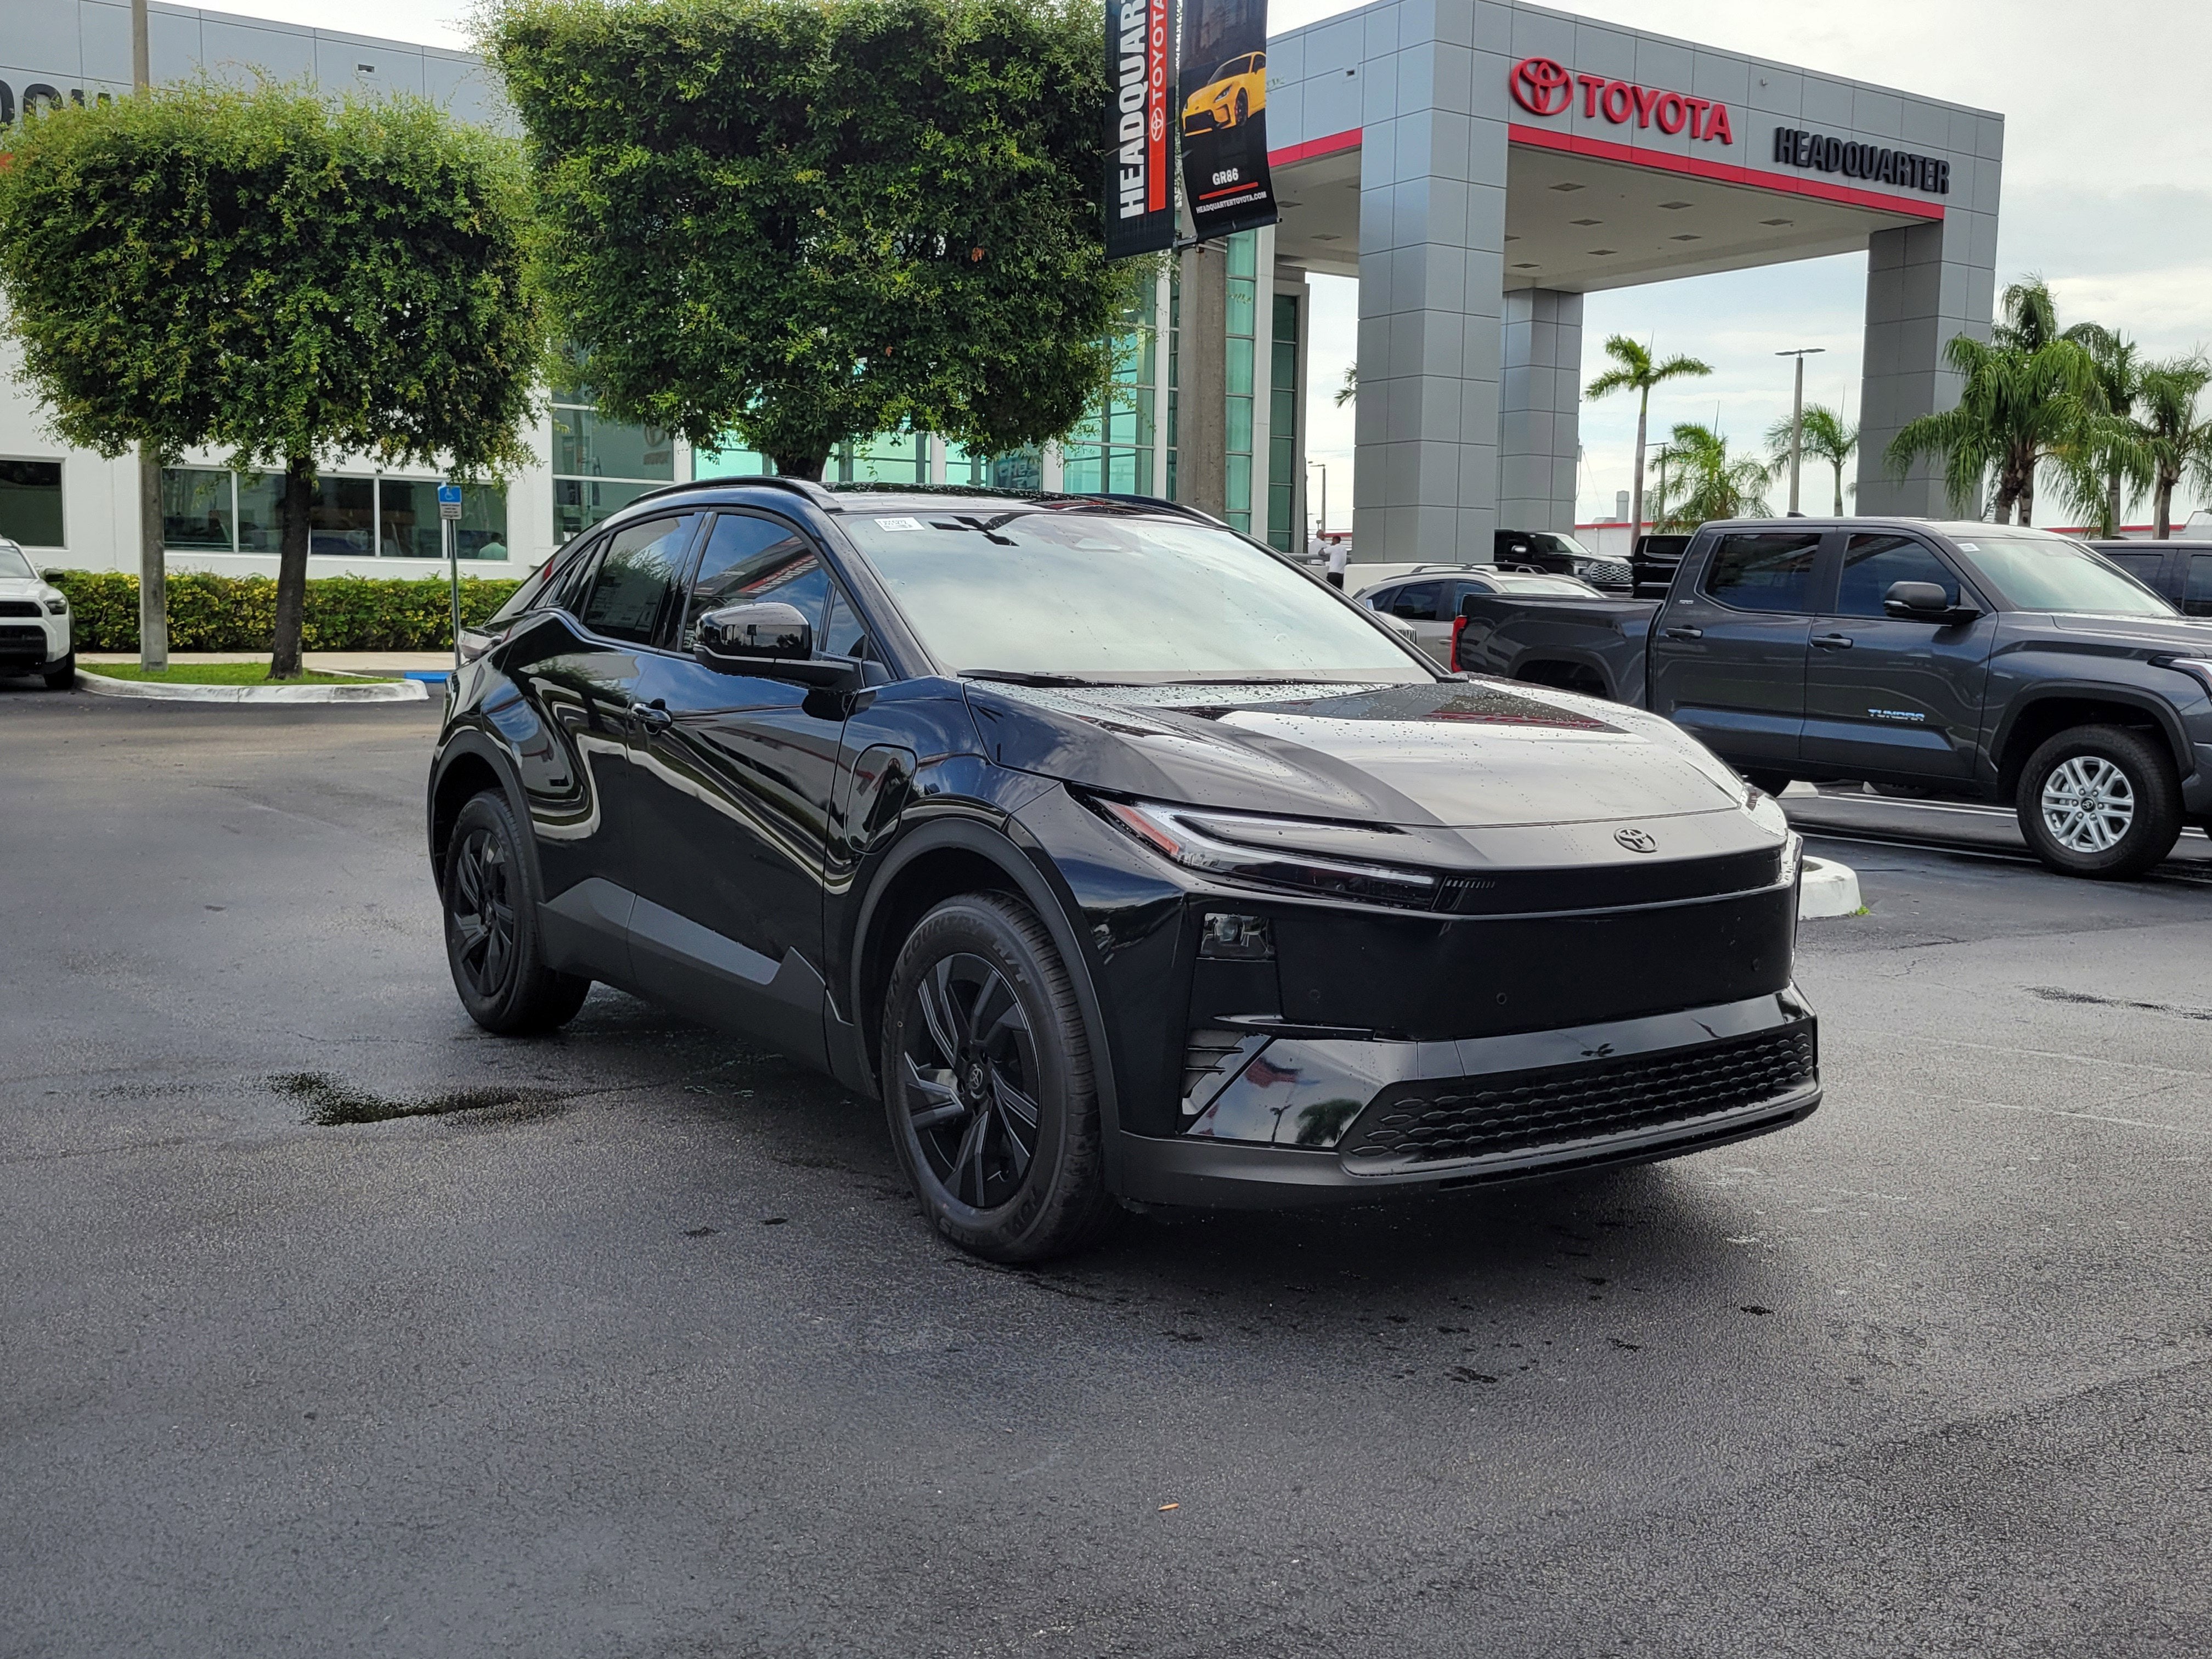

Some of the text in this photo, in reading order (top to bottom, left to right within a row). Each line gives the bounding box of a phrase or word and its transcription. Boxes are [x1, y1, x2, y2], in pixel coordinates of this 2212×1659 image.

[1578, 75, 1950, 194] TOYOTA HEADQUARTER
[1212, 168, 1239, 185] GR86
[1196, 191, 1267, 214] HEADQUARTERTOYOTA.COM
[1867, 709, 1925, 721] TUNDRA
